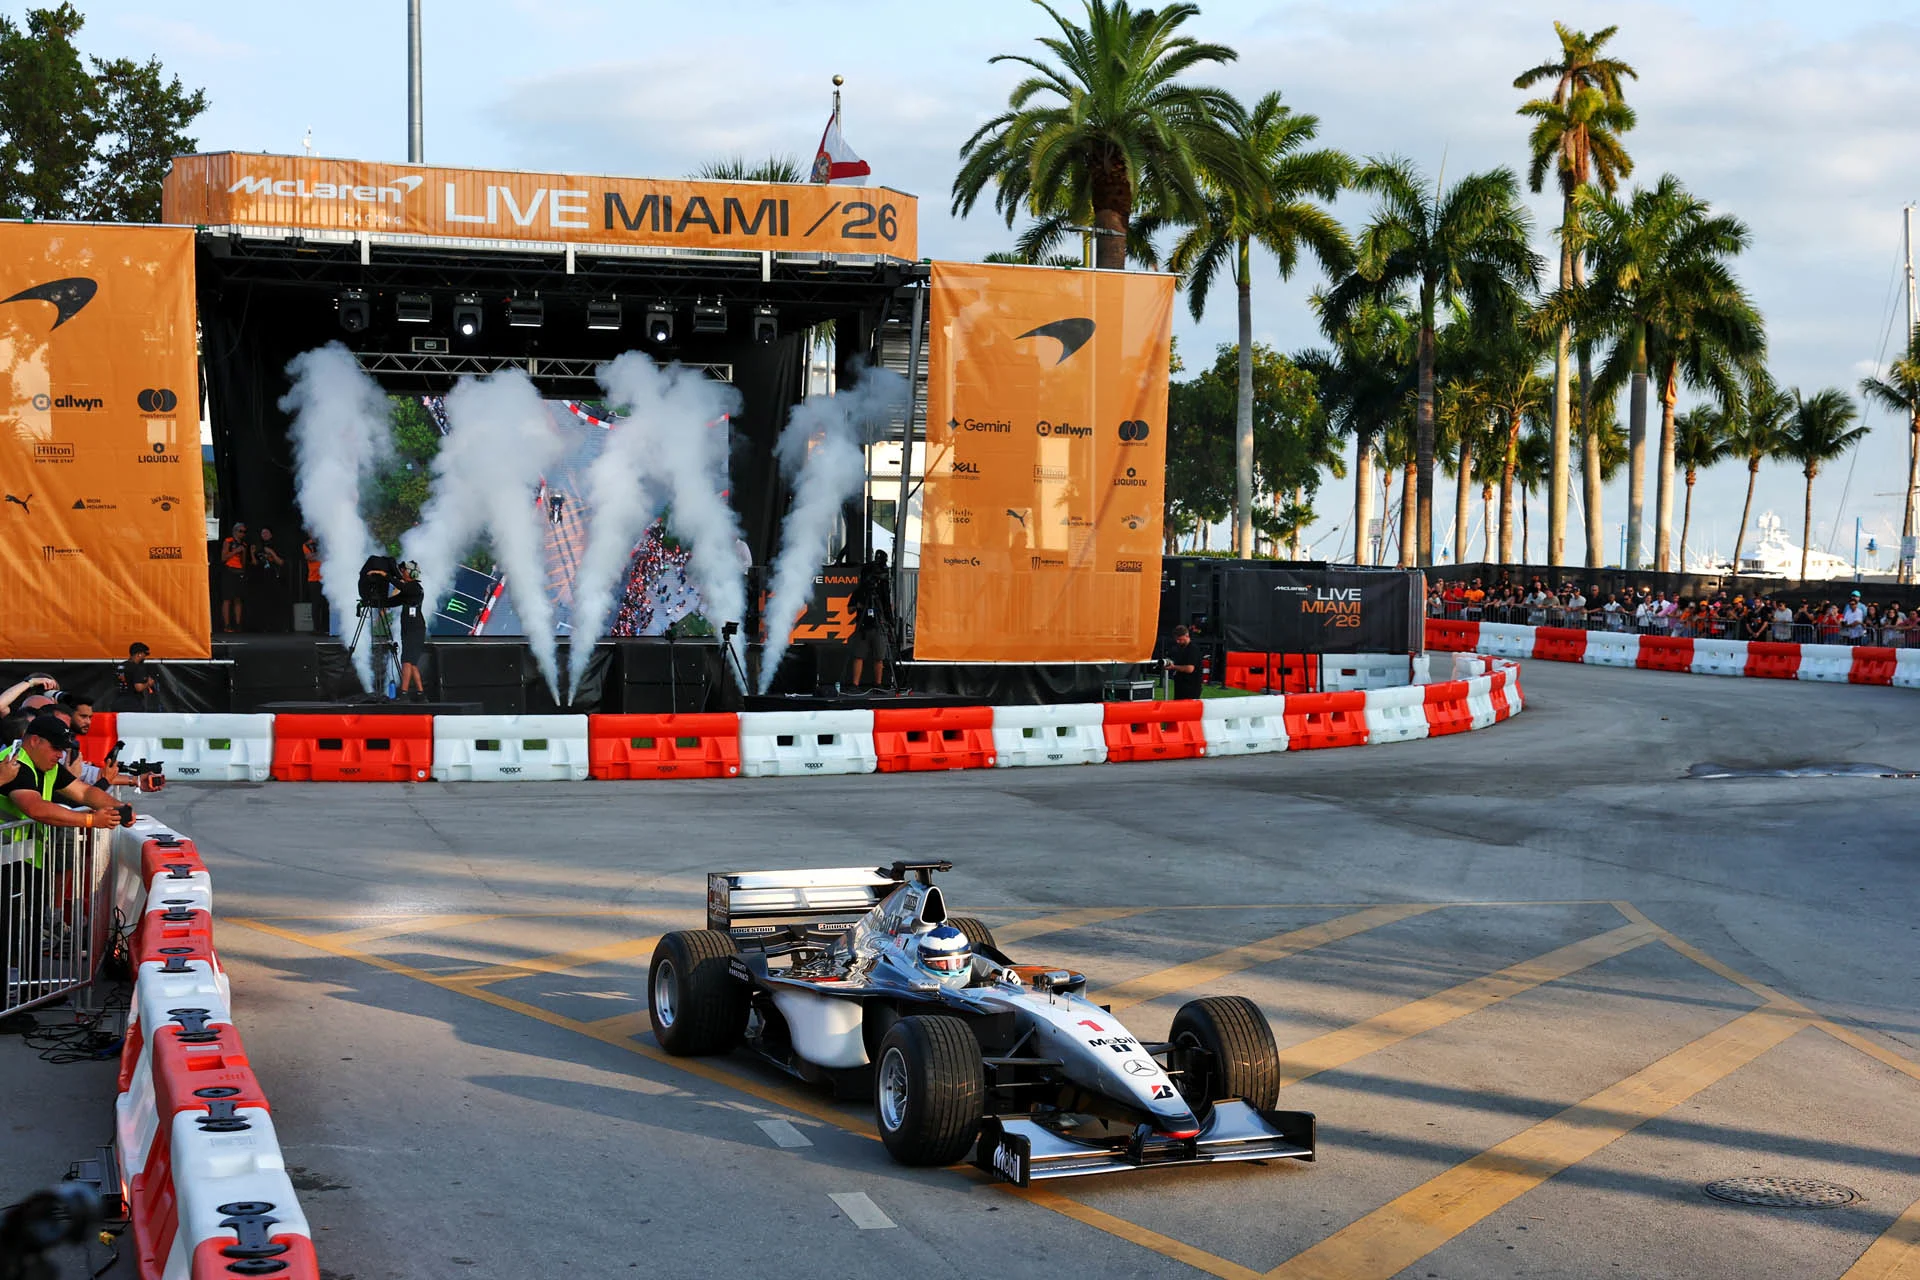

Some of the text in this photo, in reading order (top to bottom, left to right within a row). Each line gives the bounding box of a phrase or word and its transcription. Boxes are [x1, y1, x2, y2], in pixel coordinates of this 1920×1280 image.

[227, 175, 402, 204] McLaren
[445, 182, 589, 229] LIVE
[604, 192, 789, 237] MIAMI
[343, 212, 402, 225] RACING
[54, 395, 103, 412] allwyn
[963, 418, 1011, 433] Gemini
[1054, 423, 1093, 439] allwyn
[37, 446, 71, 456] Hilton
[138, 455, 168, 464] LIQUID
[1113, 478, 1137, 486] LIQUID
[150, 547, 182, 556] SONIC
[944, 557, 970, 567] logitech
[1117, 560, 1143, 569] SONIC
[825, 576, 858, 584] MIAMI
[1317, 588, 1361, 600] LIVE
[1301, 600, 1361, 614] MIAMI
[1077, 1020, 1105, 1031] 1
[1088, 1036, 1137, 1047] Mobil
[993, 1140, 1021, 1183] Mobil
